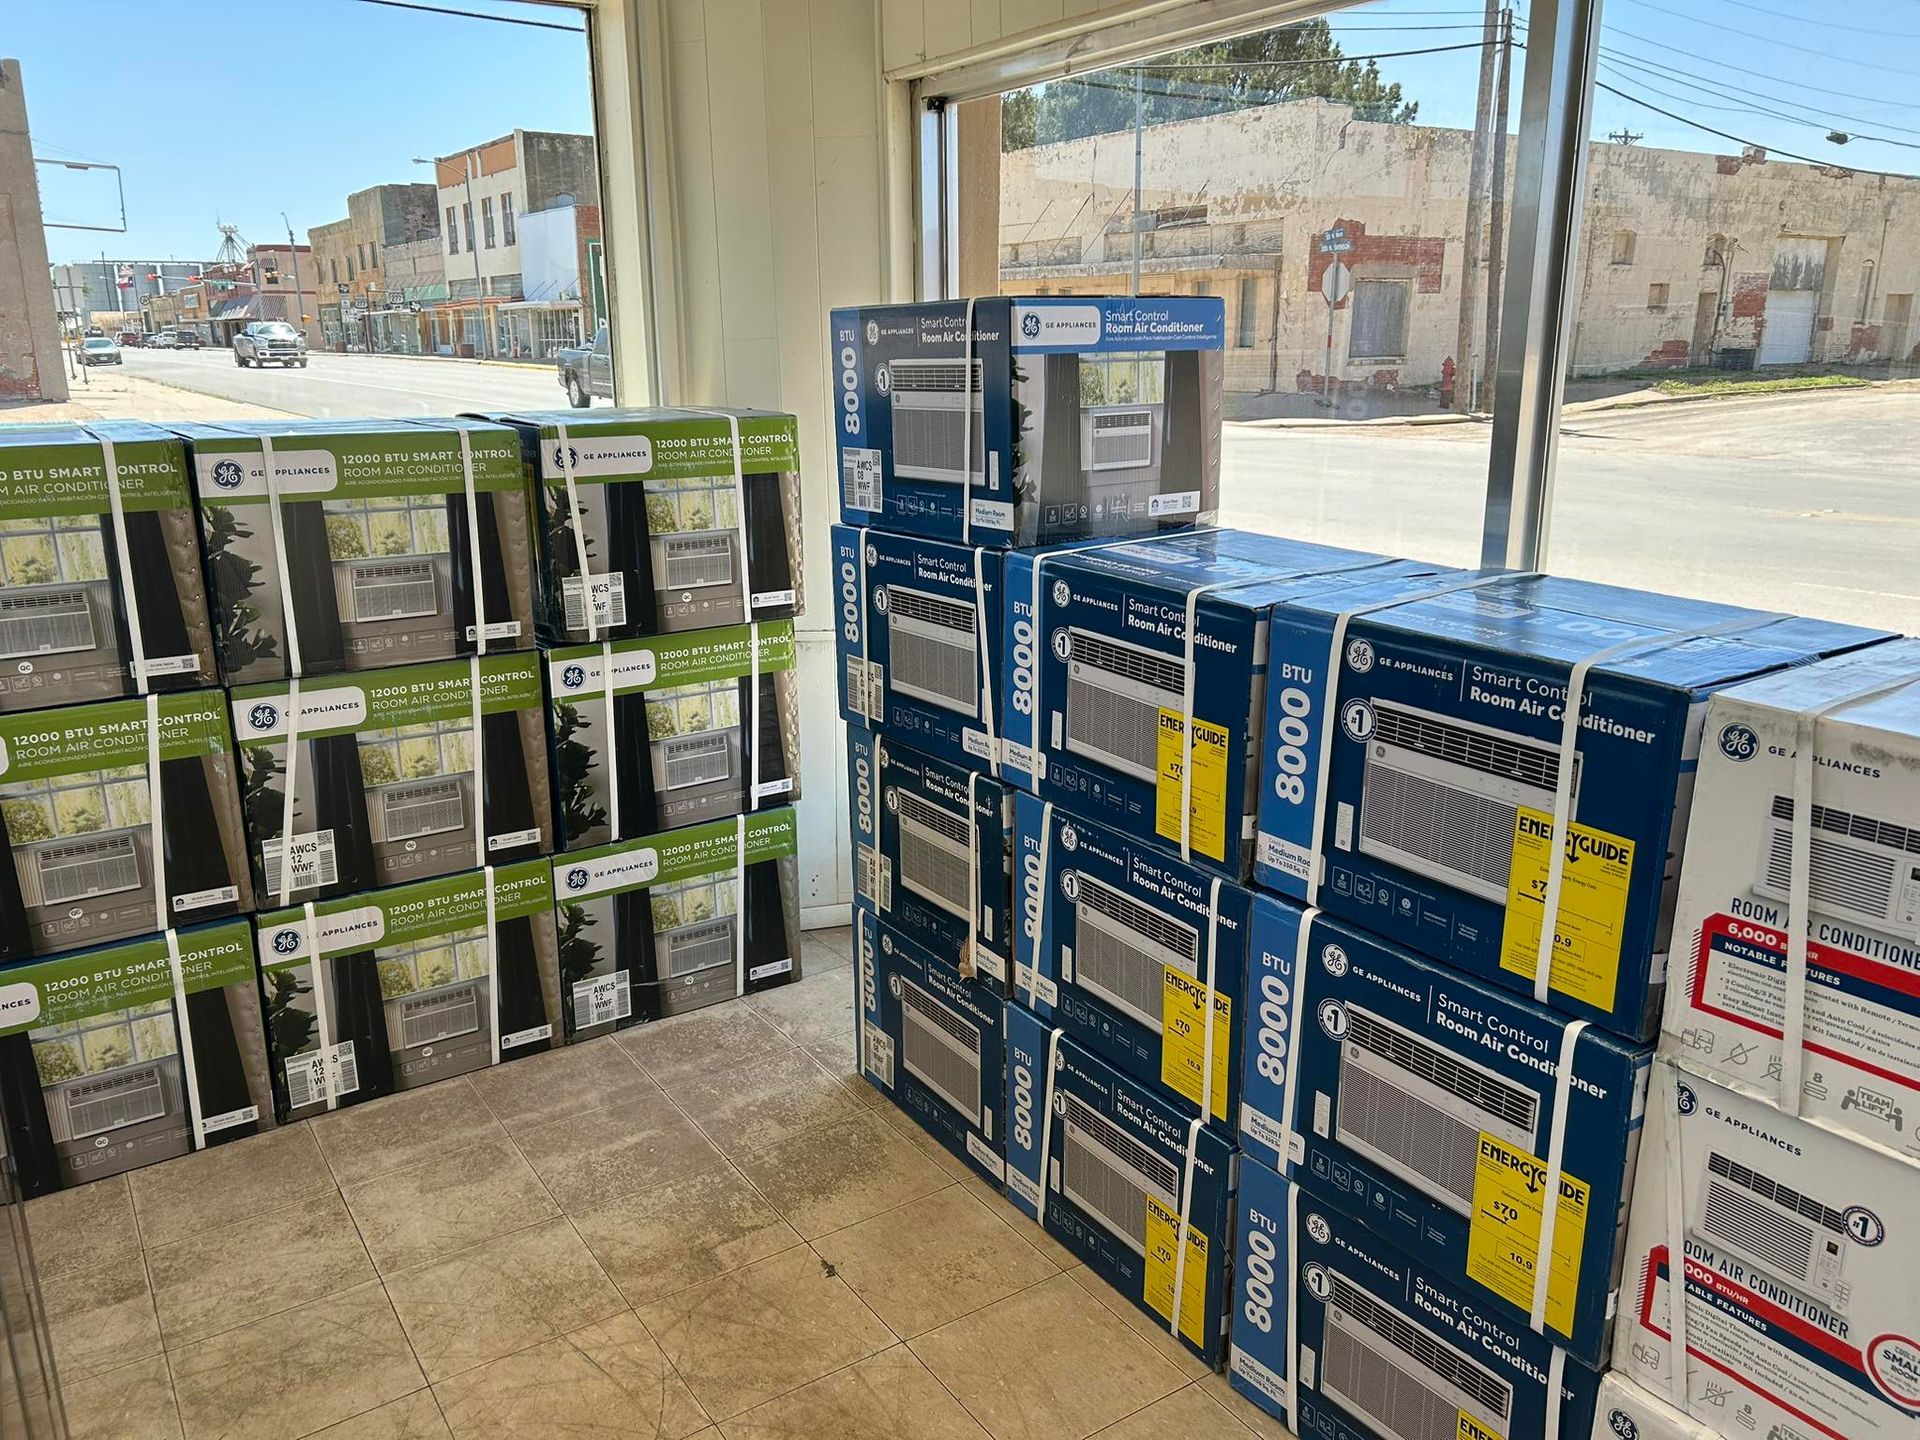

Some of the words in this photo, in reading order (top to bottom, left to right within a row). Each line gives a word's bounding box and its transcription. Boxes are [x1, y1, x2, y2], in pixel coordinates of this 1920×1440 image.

[921, 317, 942, 329] Smart
[1045, 321, 1055, 329] GE
[1056, 321, 1096, 329] APPLIANCES
[1105, 310, 1133, 322] Smart
[1134, 310, 1169, 322] Control
[839, 329, 855, 342] BTU
[1105, 323, 1133, 334] Room
[1134, 322, 1148, 334] Air
[1149, 321, 1204, 333] Conditioner
[922, 333, 942, 344] Room
[841, 346, 861, 435] 8000
[656, 439, 687, 448] 12000
[690, 438, 709, 447] BTU
[748, 434, 793, 444] CONTROL
[342, 454, 381, 464] 12000
[385, 453, 408, 463] BTU
[412, 451, 453, 461] SMART
[597, 450, 647, 459] APPLIANCES
[657, 451, 688, 461] ROOM
[690, 450, 706, 459] AIR
[13, 469, 43, 481] BTU
[50, 466, 100, 479] SMART
[344, 468, 380, 478] ROOM
[385, 466, 404, 475] AIR
[14, 484, 39, 496] AIR
[840, 546, 855, 559] BTU
[917, 553, 940, 569] Smart
[940, 557, 967, 573] Control
[918, 568, 938, 581] Room
[841, 562, 860, 644] 8000
[1014, 601, 1032, 617] BTU
[1081, 595, 1118, 611] APPLIANCES
[1128, 599, 1158, 617] Smart
[1128, 615, 1156, 632] Room
[1157, 622, 1172, 636] Air
[659, 649, 689, 660] 12000
[692, 646, 711, 656] BTU
[713, 642, 745, 654] SMART
[660, 660, 690, 671] ROOM
[691, 657, 707, 667] AIR
[1012, 620, 1032, 715] 8000
[1282, 663, 1312, 684] BTU
[1379, 656, 1393, 667] GE
[1395, 659, 1454, 681] APPLIANCES
[370, 685, 407, 698] 12000
[411, 682, 435, 693] BTU
[480, 670, 535, 684] CONTROL
[1472, 666, 1521, 691] Smart
[301, 701, 360, 715] APPLIANCES
[372, 697, 409, 710] ROOM
[411, 694, 430, 705] AIR
[1470, 687, 1515, 714] Room
[1519, 697, 1543, 717] Air
[1350, 708, 1365, 732] #1
[12, 731, 60, 746] 12000
[65, 727, 94, 738] BTU
[99, 719, 148, 735] SMART
[15, 746, 61, 761] ROOM
[66, 741, 90, 753] AIR
[1275, 688, 1312, 805] 8000
[1768, 745, 1787, 758] GE
[925, 767, 945, 783] Smart
[855, 757, 872, 835] 8000
[290, 842, 317, 855] AWCS
[662, 844, 691, 857] 12000
[694, 839, 713, 851] BTU
[749, 823, 791, 838] CONTROL
[1024, 835, 1041, 854] BTU
[1519, 816, 1629, 866] ENEYGUIDE
[663, 855, 691, 867] ROOM
[693, 850, 709, 861] AIR
[1088, 845, 1124, 866] APPLIANCES
[291, 861, 314, 873] WWF
[606, 861, 653, 876] APPLIANCES
[1133, 857, 1162, 879] Smart
[1163, 871, 1202, 898] Control
[388, 901, 424, 916] 12000
[427, 896, 450, 908] BTU
[496, 876, 547, 893] CONTROL
[1132, 873, 1159, 895] Room
[1160, 884, 1175, 902] Air
[390, 912, 425, 926] ROOM
[428, 908, 446, 919] AIR
[1731, 897, 1778, 928] ROOM
[322, 919, 378, 937] APPLIANCES
[1727, 921, 1778, 948] 6,000
[1262, 950, 1291, 976] BTU
[1724, 942, 1777, 965] NOTABLE
[44, 974, 89, 993] 12000
[93, 968, 122, 982] BTU
[126, 956, 171, 975] SMART
[178, 943, 243, 963] CONTROL
[593, 982, 615, 994] AWCS
[927, 963, 947, 984] Smart
[947, 972, 972, 999] Control
[1352, 964, 1366, 977] GE
[1366, 970, 1422, 1003] APPLIANCES
[47, 988, 91, 1005] ROOM
[94, 981, 117, 995] AIR
[594, 998, 612, 1009] WWF
[928, 974, 946, 994] Room
[956, 993, 995, 1026] Conditioner
[1326, 1008, 1340, 1033] #1
[1841, 999, 1859, 1011] with
[1860, 1006, 1891, 1021] Remote
[1175, 1018, 1191, 1034] $70
[1257, 974, 1290, 1086] 8000
[1437, 992, 1485, 1024] Smart
[1487, 1013, 1550, 1055] Control
[1826, 1013, 1846, 1024] Auto
[1847, 1020, 1865, 1031] Cool
[1435, 1011, 1479, 1043] Room
[1481, 1031, 1505, 1056] Air
[1826, 1029, 1860, 1047] Included
[1014, 1046, 1032, 1066] BTU
[1187, 1058, 1201, 1071] 10.9
[1075, 1069, 1108, 1095] APPLIANCES
[1014, 1065, 1033, 1150] 8000
[1860, 1091, 1891, 1110] TEAM
[1860, 1101, 1886, 1115] LIFT
[1116, 1104, 1142, 1128] Room
[1143, 1118, 1158, 1137] Air
[1117, 1089, 1145, 1114] Smart
[1145, 1105, 1182, 1138] Control
[1705, 1106, 1721, 1118] GE
[1724, 1114, 1803, 1157] APPLIANCES
[1493, 1199, 1519, 1221] $70
[1249, 1208, 1277, 1234] BTU
[1853, 1216, 1869, 1238] #1
[1156, 1245, 1171, 1262] $70
[1334, 1237, 1347, 1250] GE
[1347, 1243, 1401, 1281] APPLIANCES
[1510, 1251, 1534, 1271] 10.9
[1244, 1230, 1277, 1333] 8000
[1310, 1272, 1323, 1294] #1
[1716, 1284, 1750, 1305] BTU/HR
[1719, 1258, 1744, 1282] AIR
[1749, 1274, 1850, 1340] CONDITIONER
[1414, 1293, 1453, 1327] Room
[1456, 1319, 1480, 1347] Air
[1415, 1276, 1458, 1314] Smart
[1462, 1305, 1520, 1351] Control
[1716, 1296, 1768, 1332] FEATURES
[1890, 1364, 1918, 1384] ROOM
